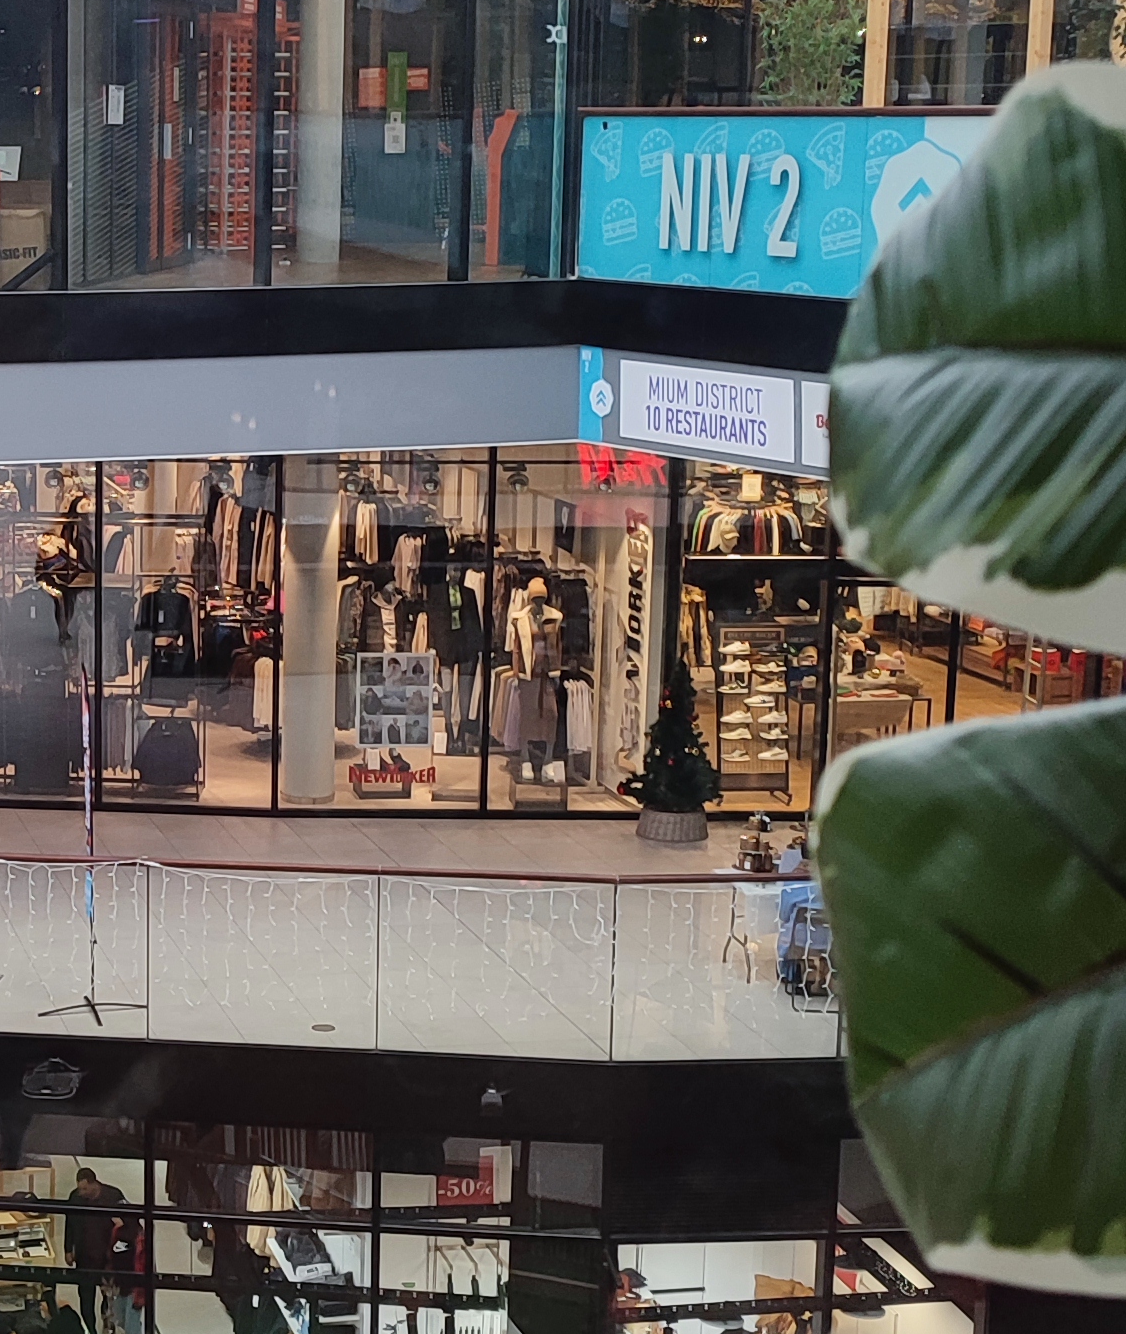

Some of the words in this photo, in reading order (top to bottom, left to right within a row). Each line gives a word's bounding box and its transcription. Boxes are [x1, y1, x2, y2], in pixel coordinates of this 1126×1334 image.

[659, 153, 751, 253] NIV
[767, 154, 800, 258] 2
[648, 375, 689, 405] MIUM
[695, 381, 763, 415] DISTRICT
[645, 405, 661, 432] 10
[666, 408, 767, 447] RESTAURANTS
[437, 1178, 493, 1198] -50%
